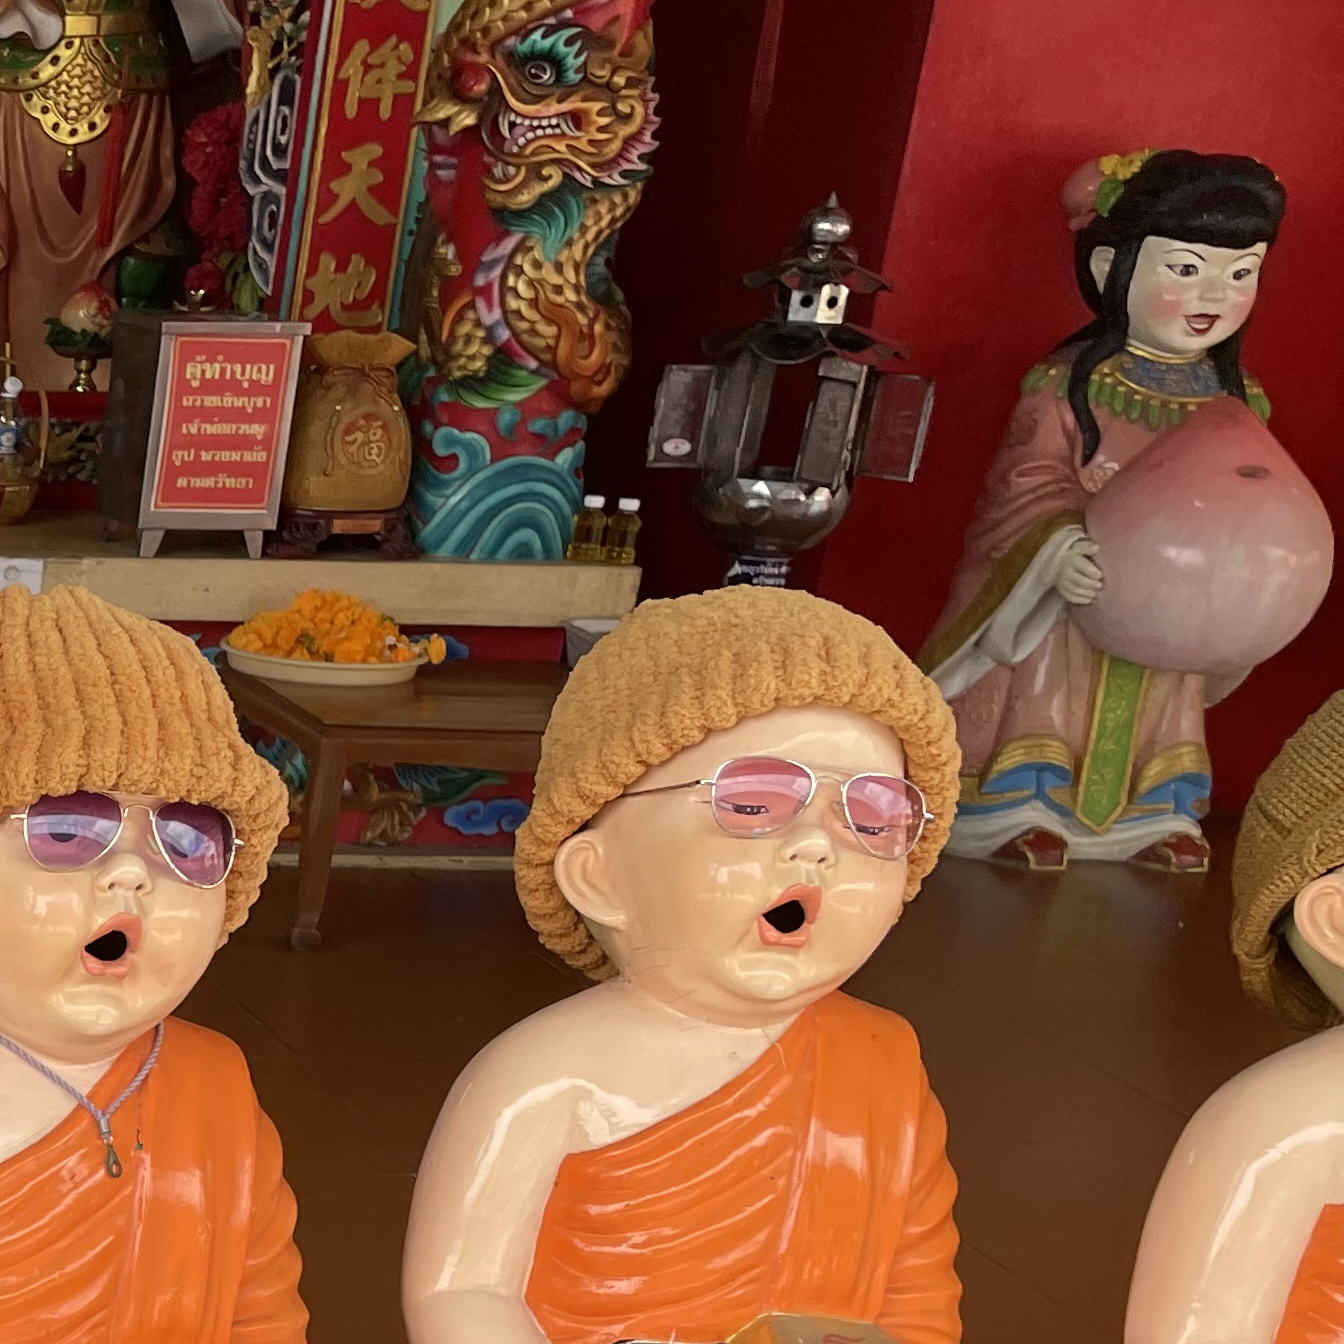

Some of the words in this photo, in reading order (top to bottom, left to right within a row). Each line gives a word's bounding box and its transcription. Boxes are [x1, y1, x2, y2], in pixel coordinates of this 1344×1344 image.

[303, 0, 429, 327] 侔天地
[185, 354, 275, 389] ตู้ทำบุญ
